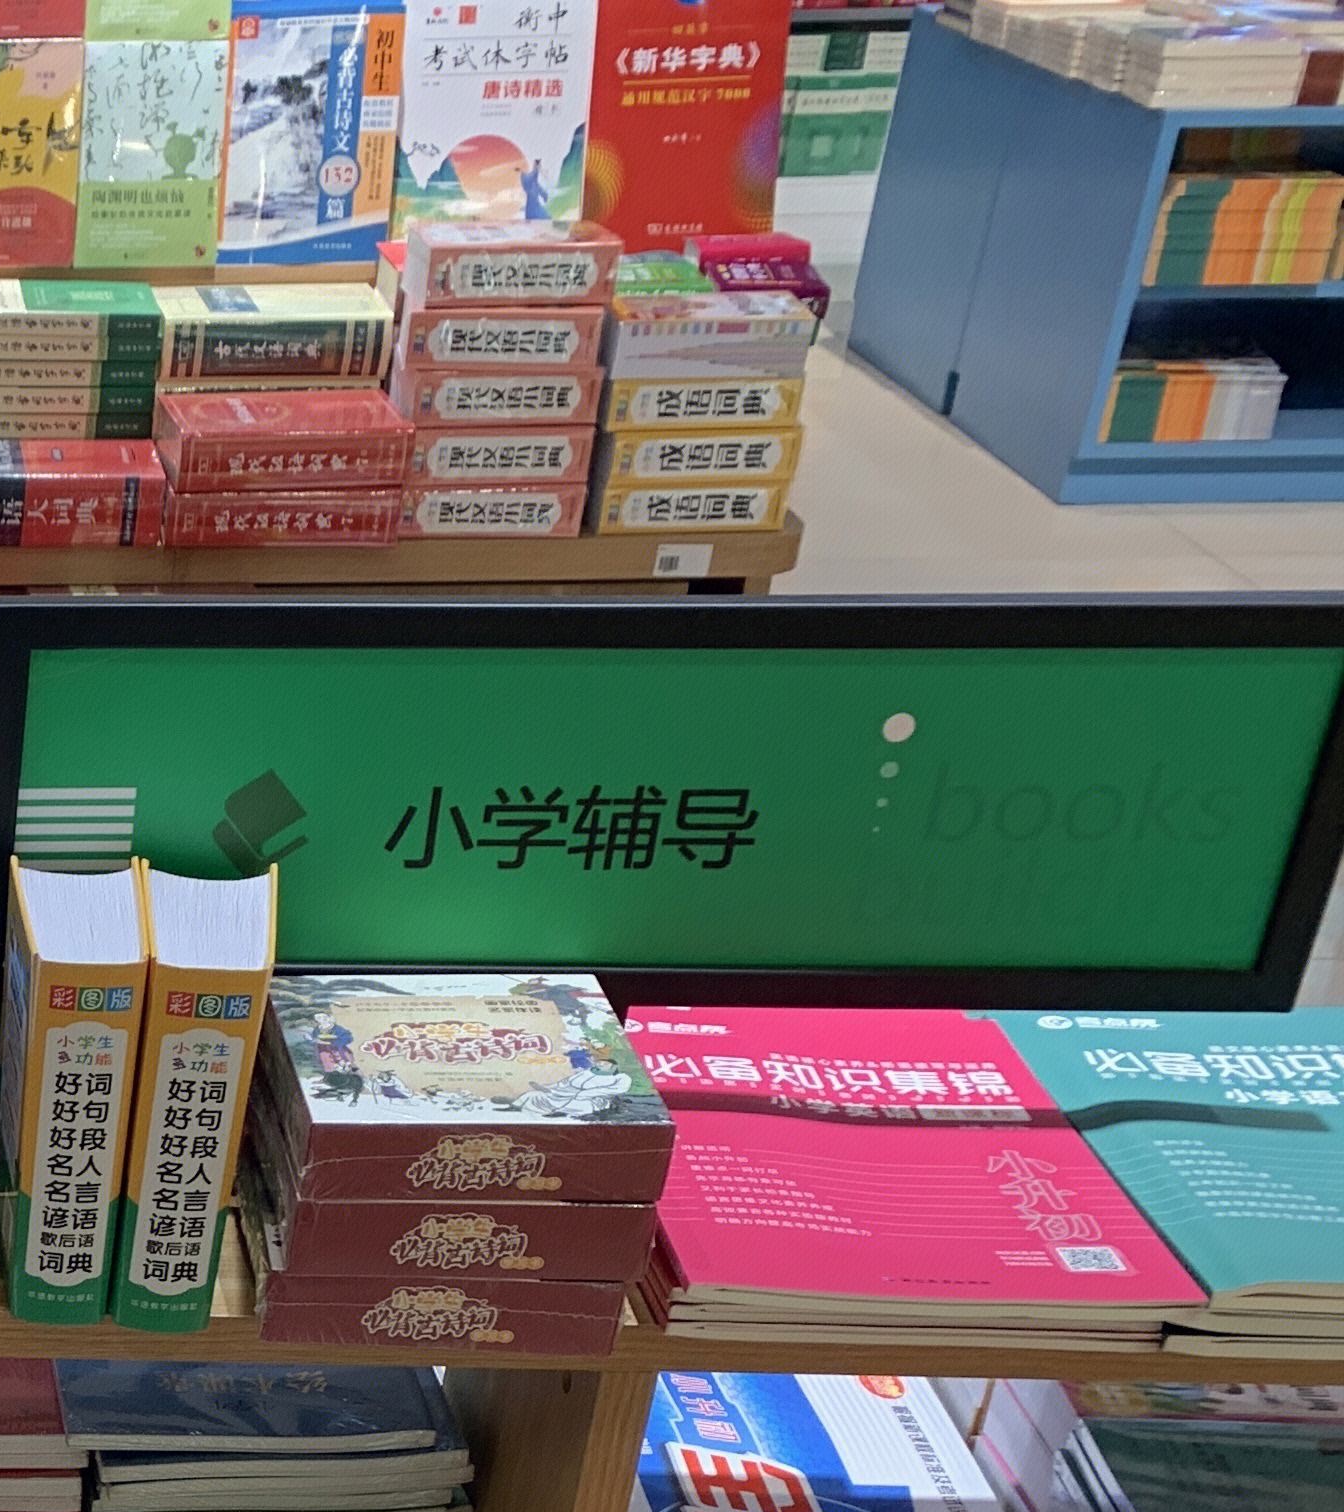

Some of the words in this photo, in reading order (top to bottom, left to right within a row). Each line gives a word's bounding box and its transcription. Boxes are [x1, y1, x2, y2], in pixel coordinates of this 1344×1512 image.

[370, 27, 396, 92] 初中生
[423, 40, 569, 72] 考试体字帖
[614, 41, 762, 77] 《新华字典》
[332, 43, 358, 153] 必背古诗文
[481, 79, 564, 100] 唐诗精选
[384, 786, 762, 873] 小学辅导
[50, 986, 133, 1012] 彩图版
[166, 991, 252, 1019] 彩图版
[57, 1035, 114, 1050] 小学生
[172, 1042, 230, 1058] 小学生
[360, 1033, 553, 1063] 必背古诗词
[57, 1052, 112, 1066] 多功能
[172, 1059, 228, 1075] 多功能
[54, 1072, 113, 1097] 好词
[645, 1053, 1013, 1097] 必备知识集锦
[168, 1078, 227, 1104] 好词
[51, 1099, 109, 1123] 好句
[164, 1106, 222, 1131] 好句
[49, 1127, 107, 1151] 好段
[160, 1134, 219, 1159] 好段
[46, 1154, 103, 1178] 名人
[156, 1162, 212, 1186] 名人
[44, 1180, 100, 1204] 名言
[152, 1189, 210, 1213] 名言
[42, 1206, 98, 1231] 谚语
[149, 1215, 206, 1240] 谚语
[40, 1231, 94, 1248] 歇后语
[145, 1240, 201, 1257] 歇后语
[38, 1251, 93, 1275] 词典
[142, 1258, 200, 1283] 词典
